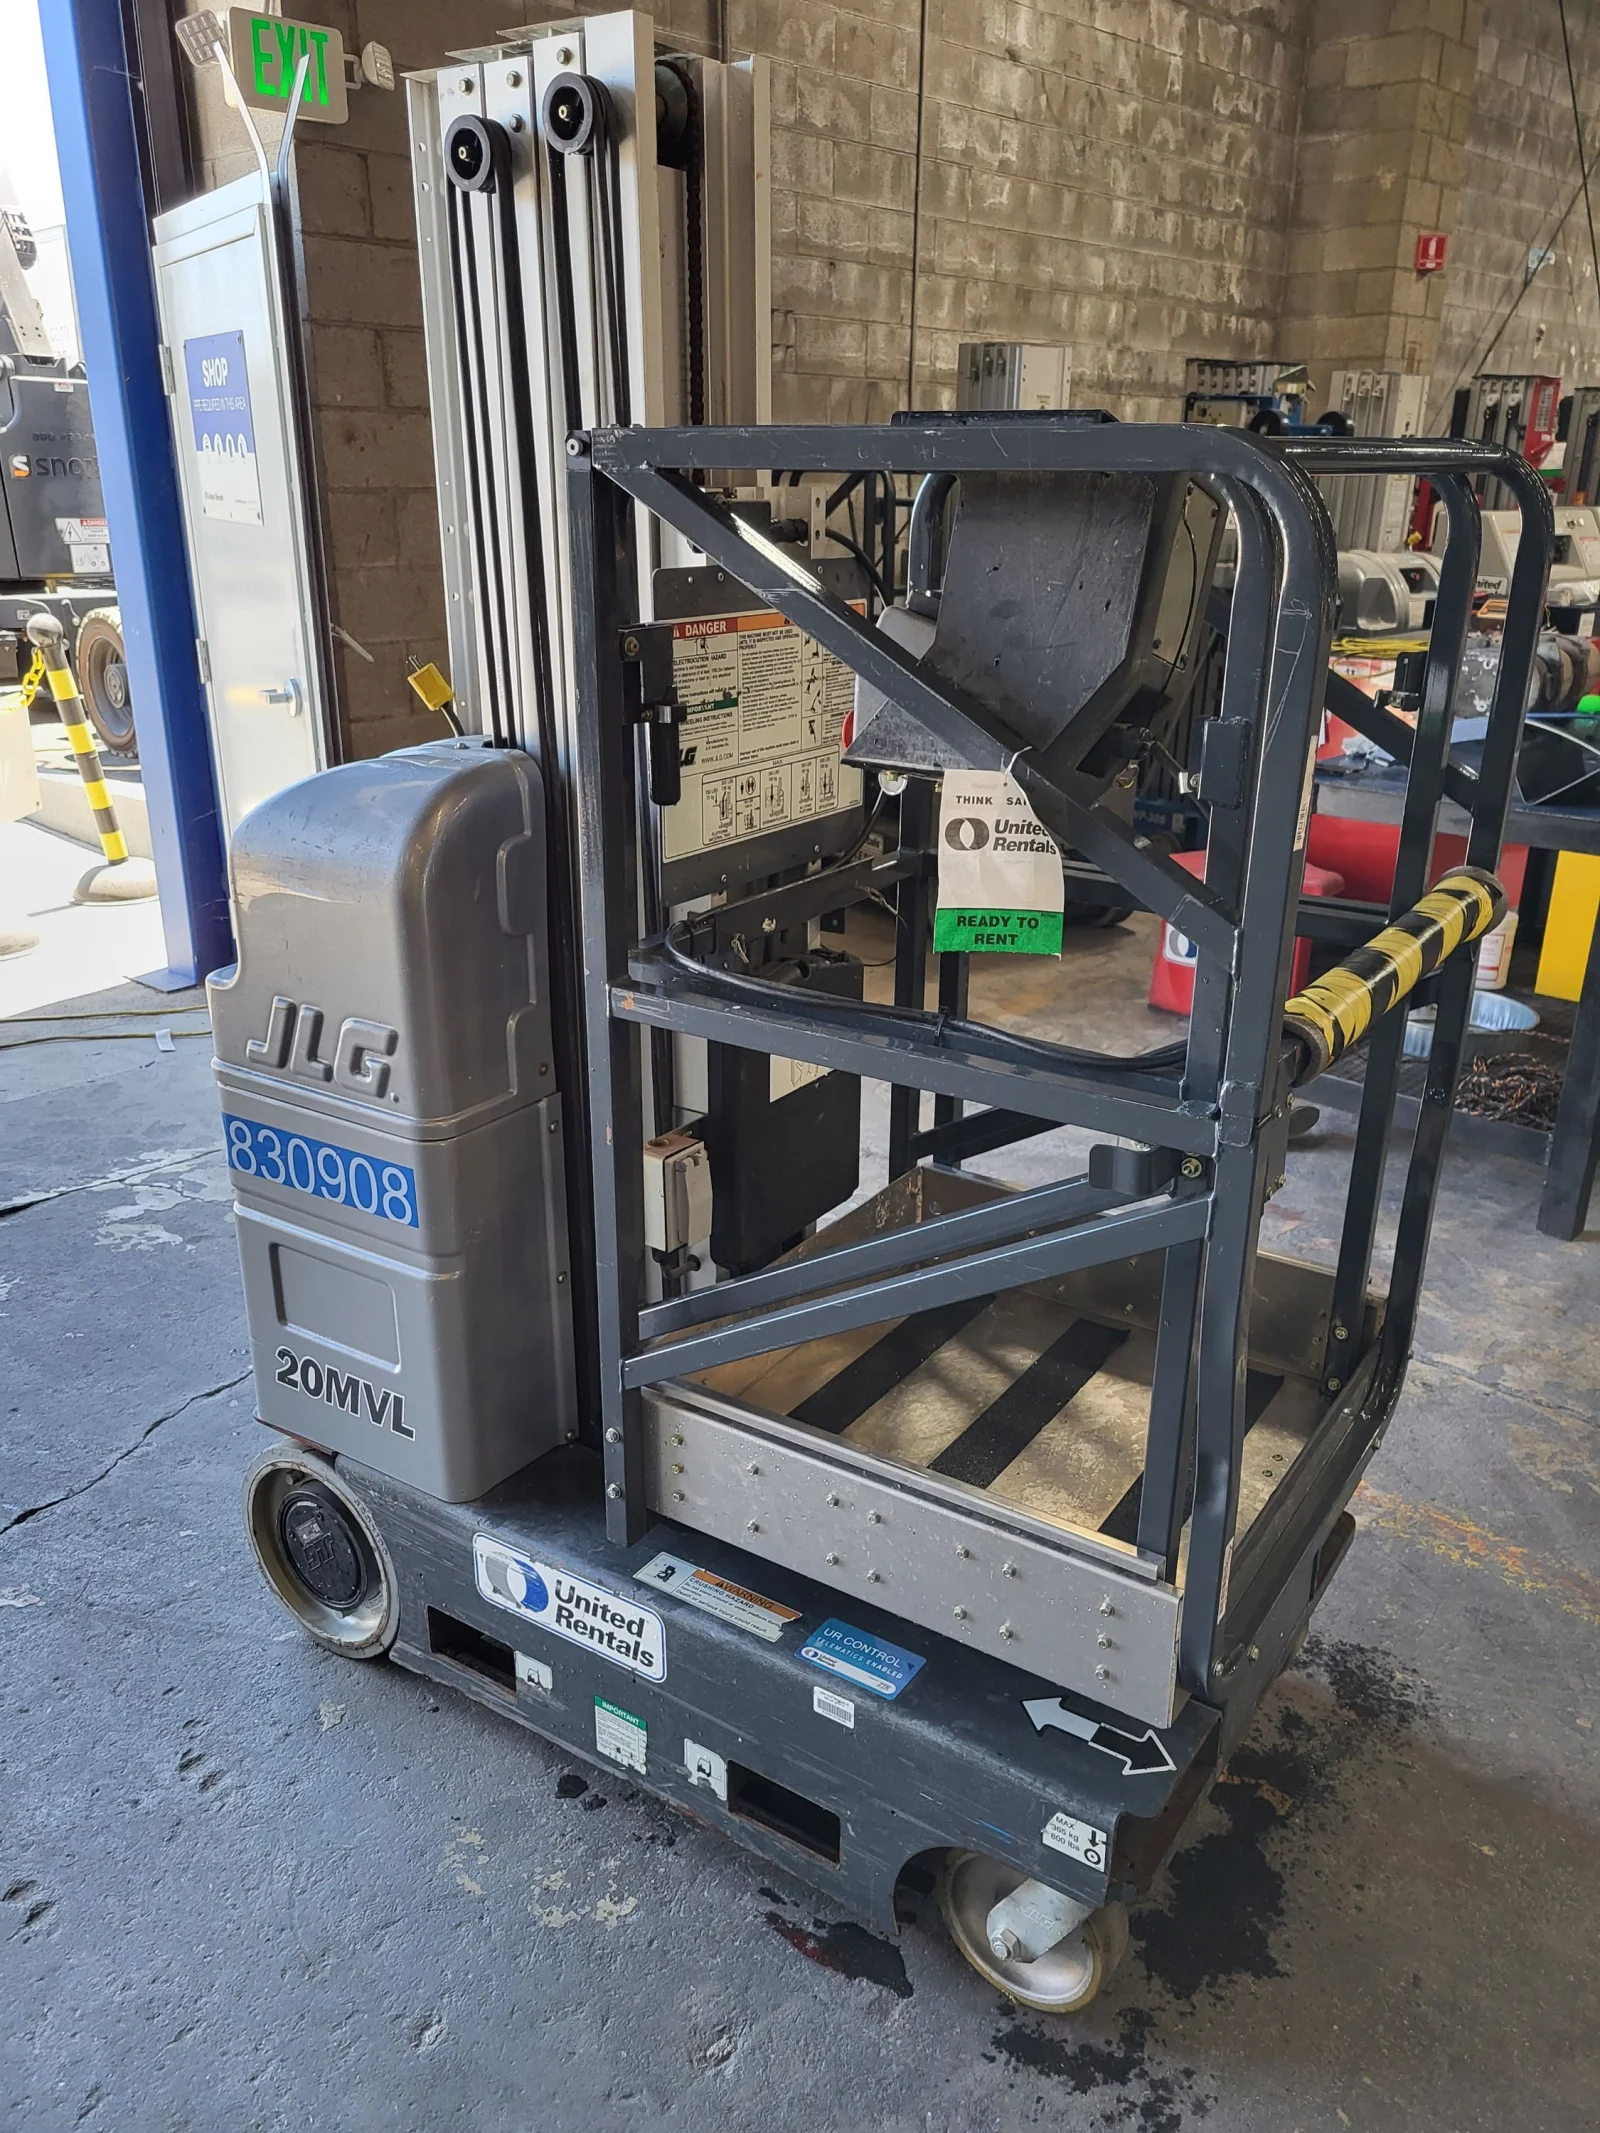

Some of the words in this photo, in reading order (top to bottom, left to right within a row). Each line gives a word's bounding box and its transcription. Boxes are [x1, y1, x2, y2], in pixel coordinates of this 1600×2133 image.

[251, 17, 329, 106] EXIT
[202, 357, 228, 388] SHOP
[1477, 579, 1502, 590] nited
[685, 621, 727, 636] DANGER
[703, 712, 733, 722] INSTRUCTIONS
[701, 752, 734, 764] WWW.JLG.COM
[956, 795, 993, 806] THINK
[992, 836, 1057, 855] Rentals
[957, 915, 1013, 928] READY
[1017, 917, 1039, 929] TO
[974, 934, 1019, 946] RENT
[246, 996, 399, 1100] JLG
[229, 1120, 413, 1226] 830908
[275, 1345, 416, 1442] 20MVL
[689, 1577, 724, 1597] CRUSHING
[726, 1593, 755, 1609] HAZARD
[723, 1581, 774, 1610] WARNING
[555, 1578, 645, 1640] United
[675, 1589, 691, 1599] Death
[698, 1598, 718, 1611] serious
[719, 1607, 733, 1620] injury
[734, 1614, 751, 1626] could
[555, 1604, 655, 1669] Rentals
[823, 1627, 843, 1641] UR
[843, 1636, 901, 1669] CONTROL
[816, 1637, 864, 1661] TELEMATICS
[865, 1659, 903, 1680] ENABLED
[602, 1701, 640, 1726] IMPORTANT
[1051, 1823, 1067, 1836] 365
[1068, 1831, 1079, 1843] kg
[1055, 1816, 1075, 1831] MAX
[1050, 1832, 1066, 1845] 800
[1067, 1840, 1080, 1852] lbs
[1020, 1906, 1056, 1931] JLG
